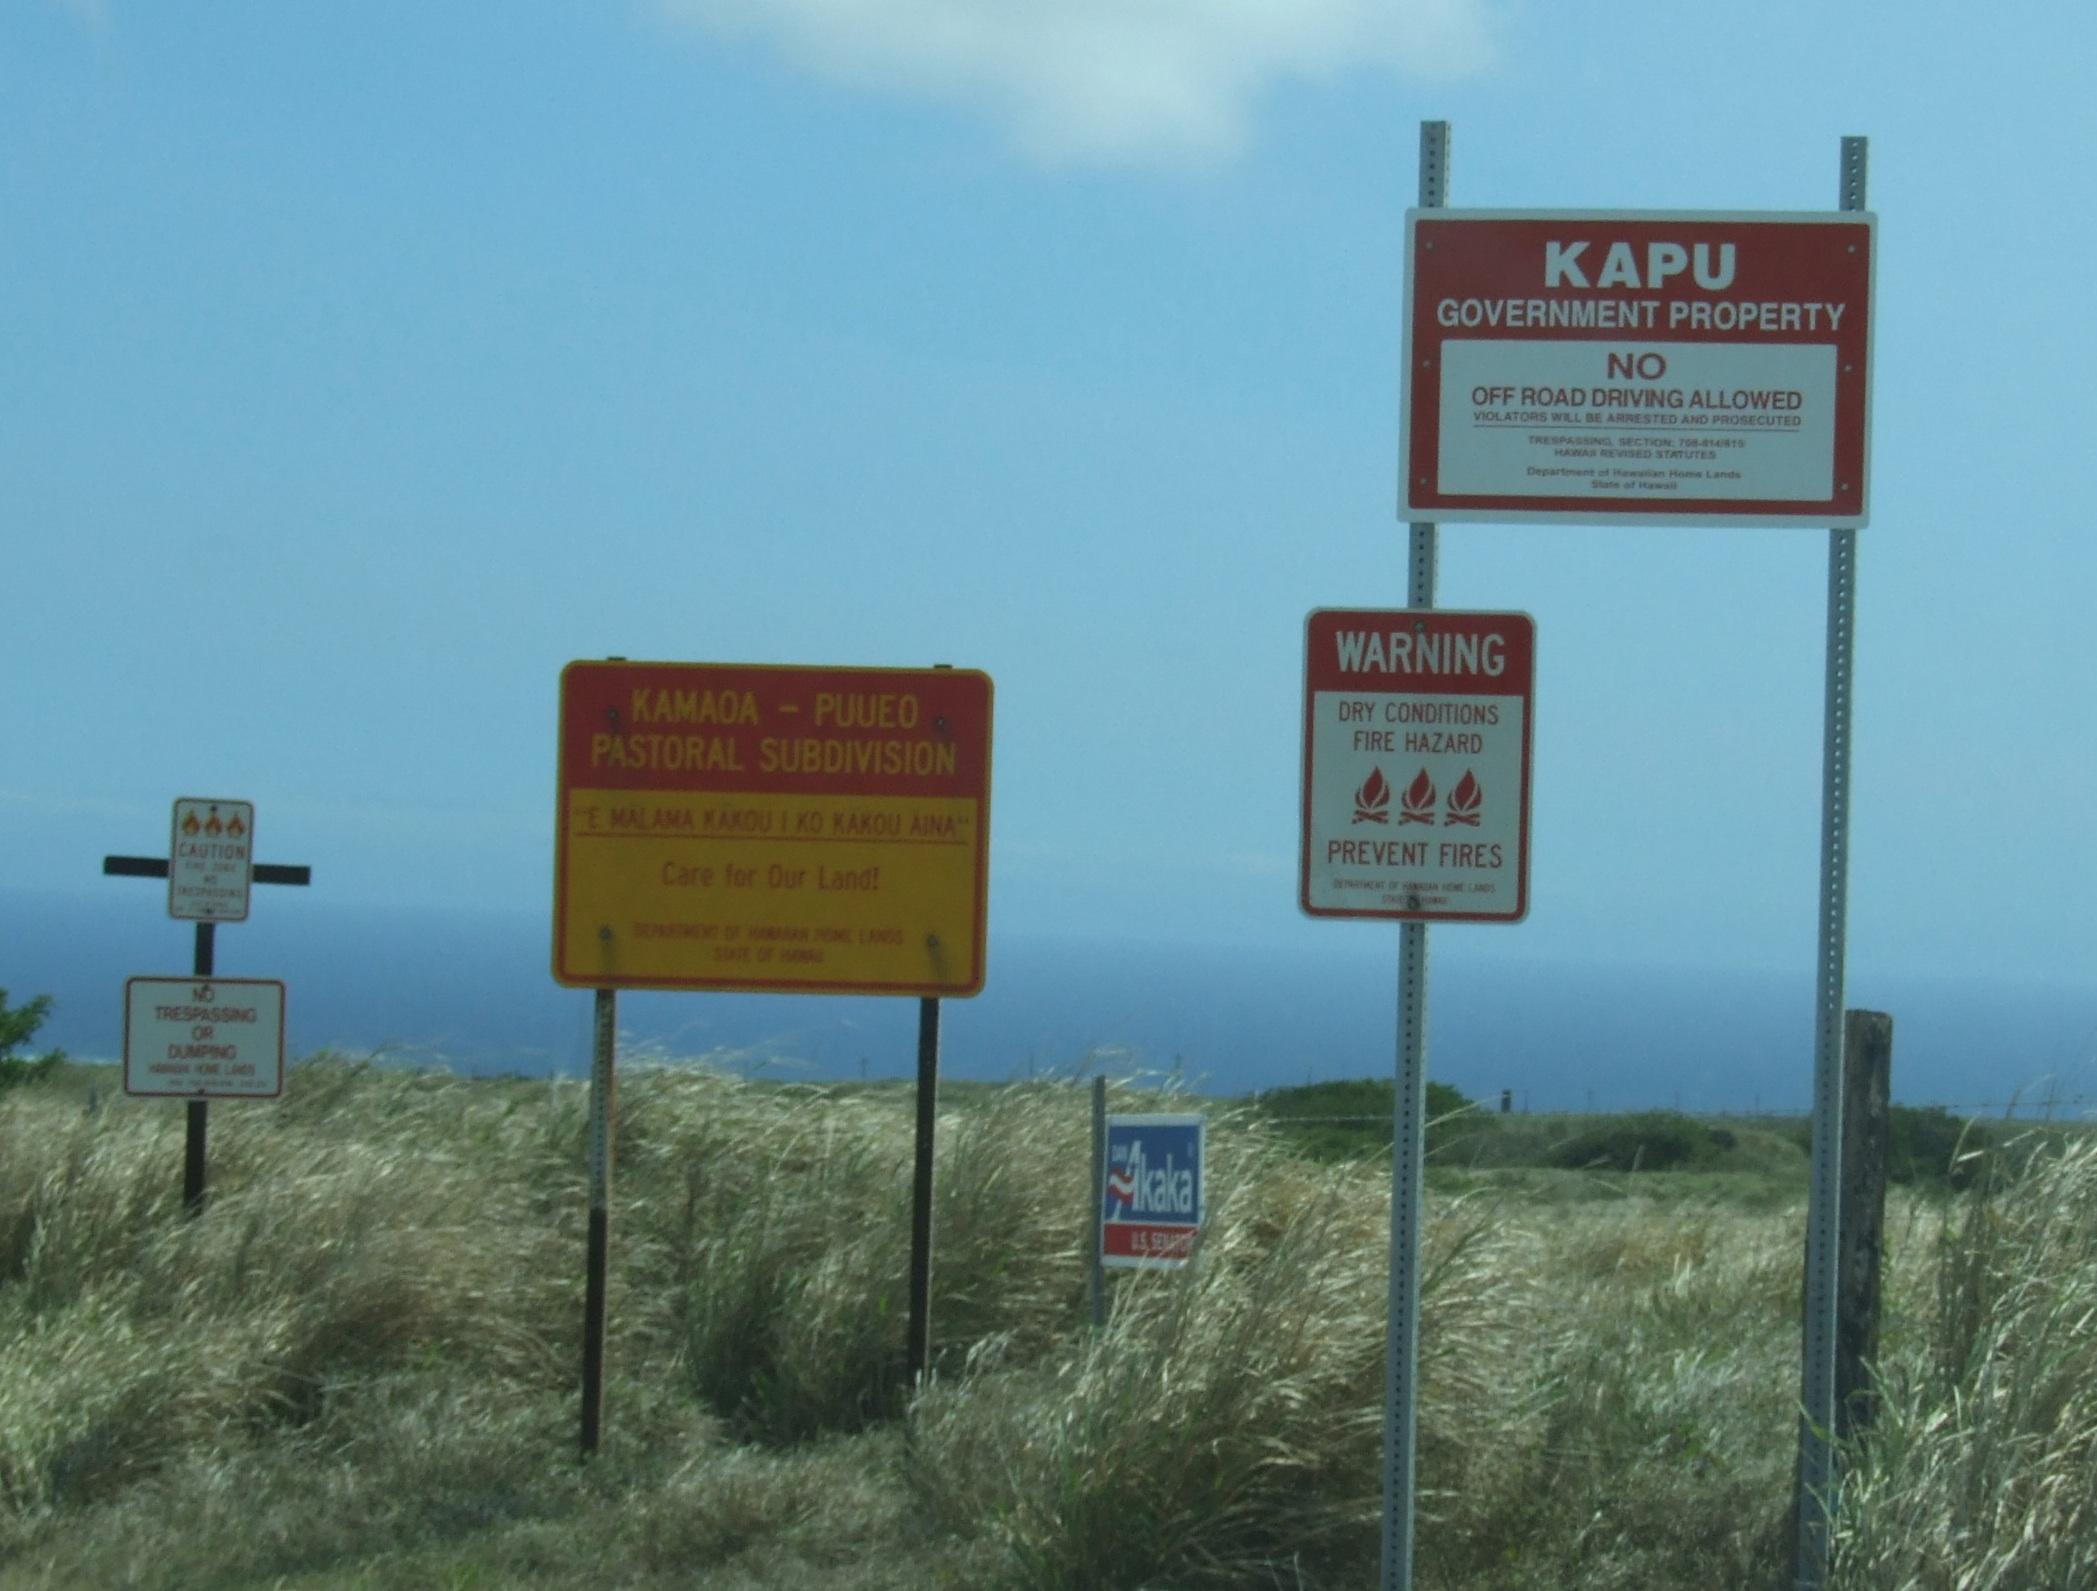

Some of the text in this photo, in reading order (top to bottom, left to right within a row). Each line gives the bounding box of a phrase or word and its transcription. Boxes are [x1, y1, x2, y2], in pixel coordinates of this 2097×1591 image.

[1545, 241, 1737, 290] KAPU
[1437, 298, 1846, 331] GOVERNMENT PROPERTY
[1607, 353, 1666, 380] NO
[1472, 386, 1803, 411] OFF ROAD DRIVING ALLOWED
[1473, 411, 1802, 427] VIOLATORS WILL BE ARRESTED AND PROSECUTED
[1600, 449, 1652, 459] REVISED
[1655, 449, 1717, 460] STATUTES
[1526, 466, 1594, 478] Department
[1598, 467, 1610, 477] of
[1669, 469, 1702, 479] Home
[1706, 470, 1742, 480] Lands
[1591, 480, 1620, 489] State
[1623, 480, 1636, 490] of
[1336, 631, 1505, 677] WARNING
[631, 689, 759, 726] KAMAOA
[814, 693, 919, 729] PUUEO
[1339, 702, 1499, 725] DRY CONDITIONS
[1354, 731, 1483, 754] FIRE HAZARD
[591, 734, 957, 776] PASTORAL SUBDIVISION
[178, 843, 246, 860] CAUTION
[1328, 840, 1503, 869] PREVENT FIRES
[661, 861, 881, 891] Care for Our Land!
[192, 987, 215, 1004] NO
[155, 1006, 257, 1024] TRESPASSING
[192, 1025, 214, 1041] OR
[167, 1043, 237, 1060] DUMPING
[1118, 1139, 1192, 1214] Akaka
